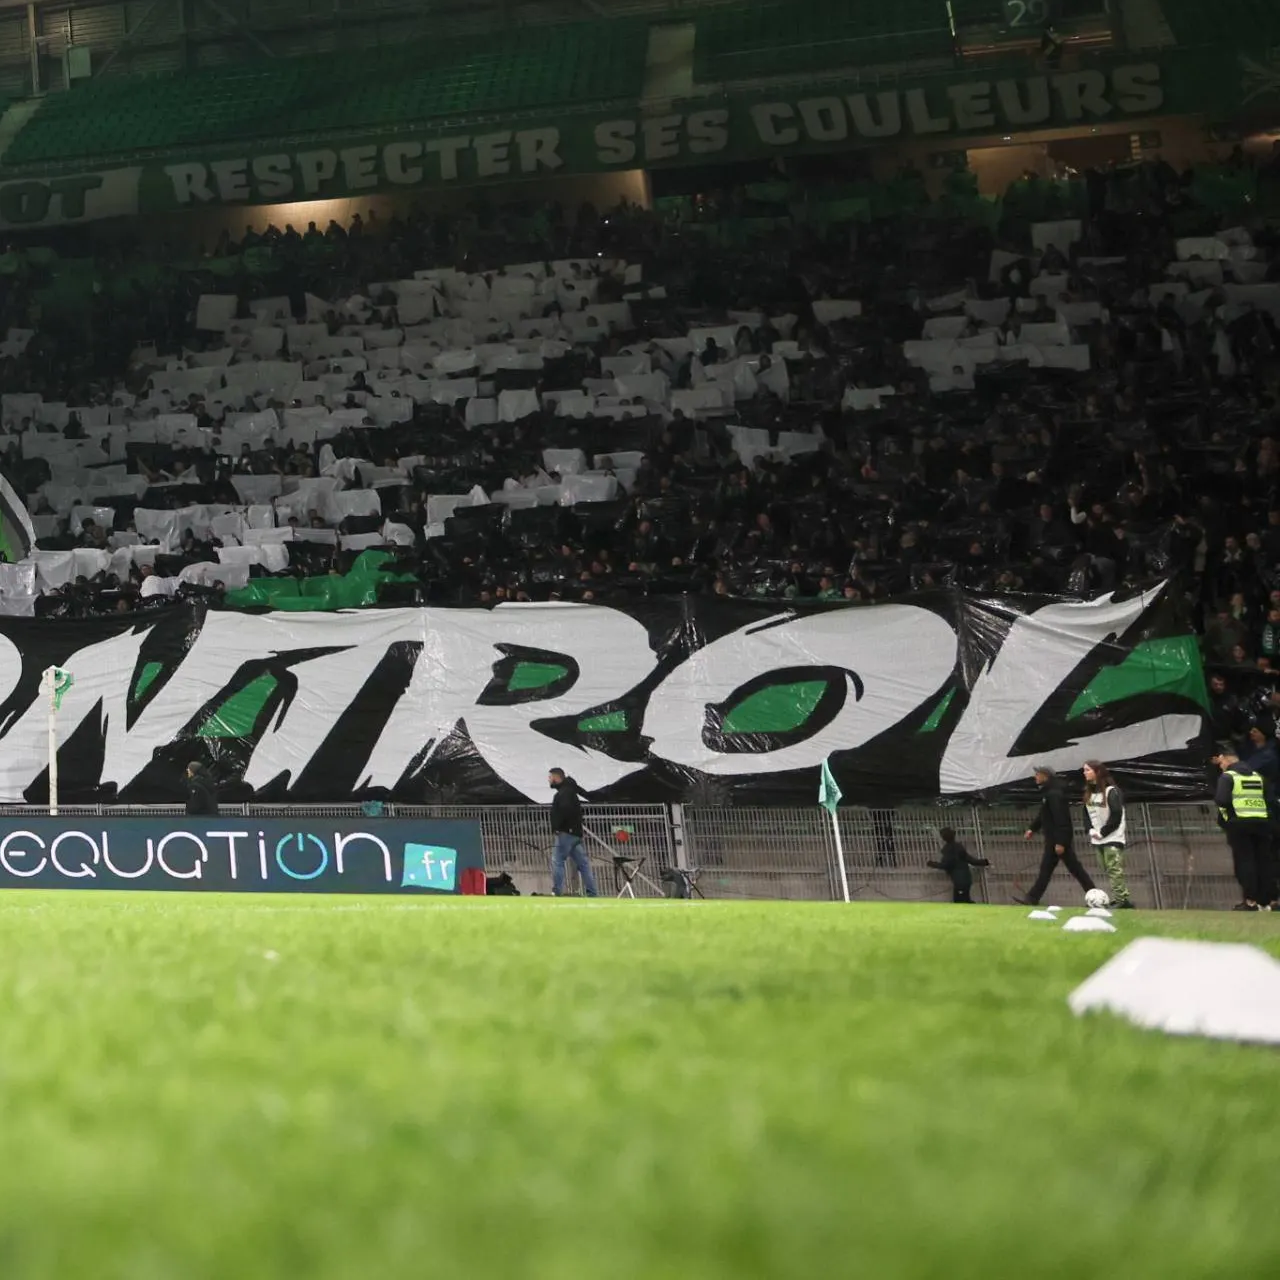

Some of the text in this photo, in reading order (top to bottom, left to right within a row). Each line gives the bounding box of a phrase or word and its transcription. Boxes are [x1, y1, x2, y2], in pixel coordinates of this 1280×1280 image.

[163, 125, 565, 205] RESPECTER
[594, 108, 730, 167] SES
[750, 63, 1166, 146] COULEURS
